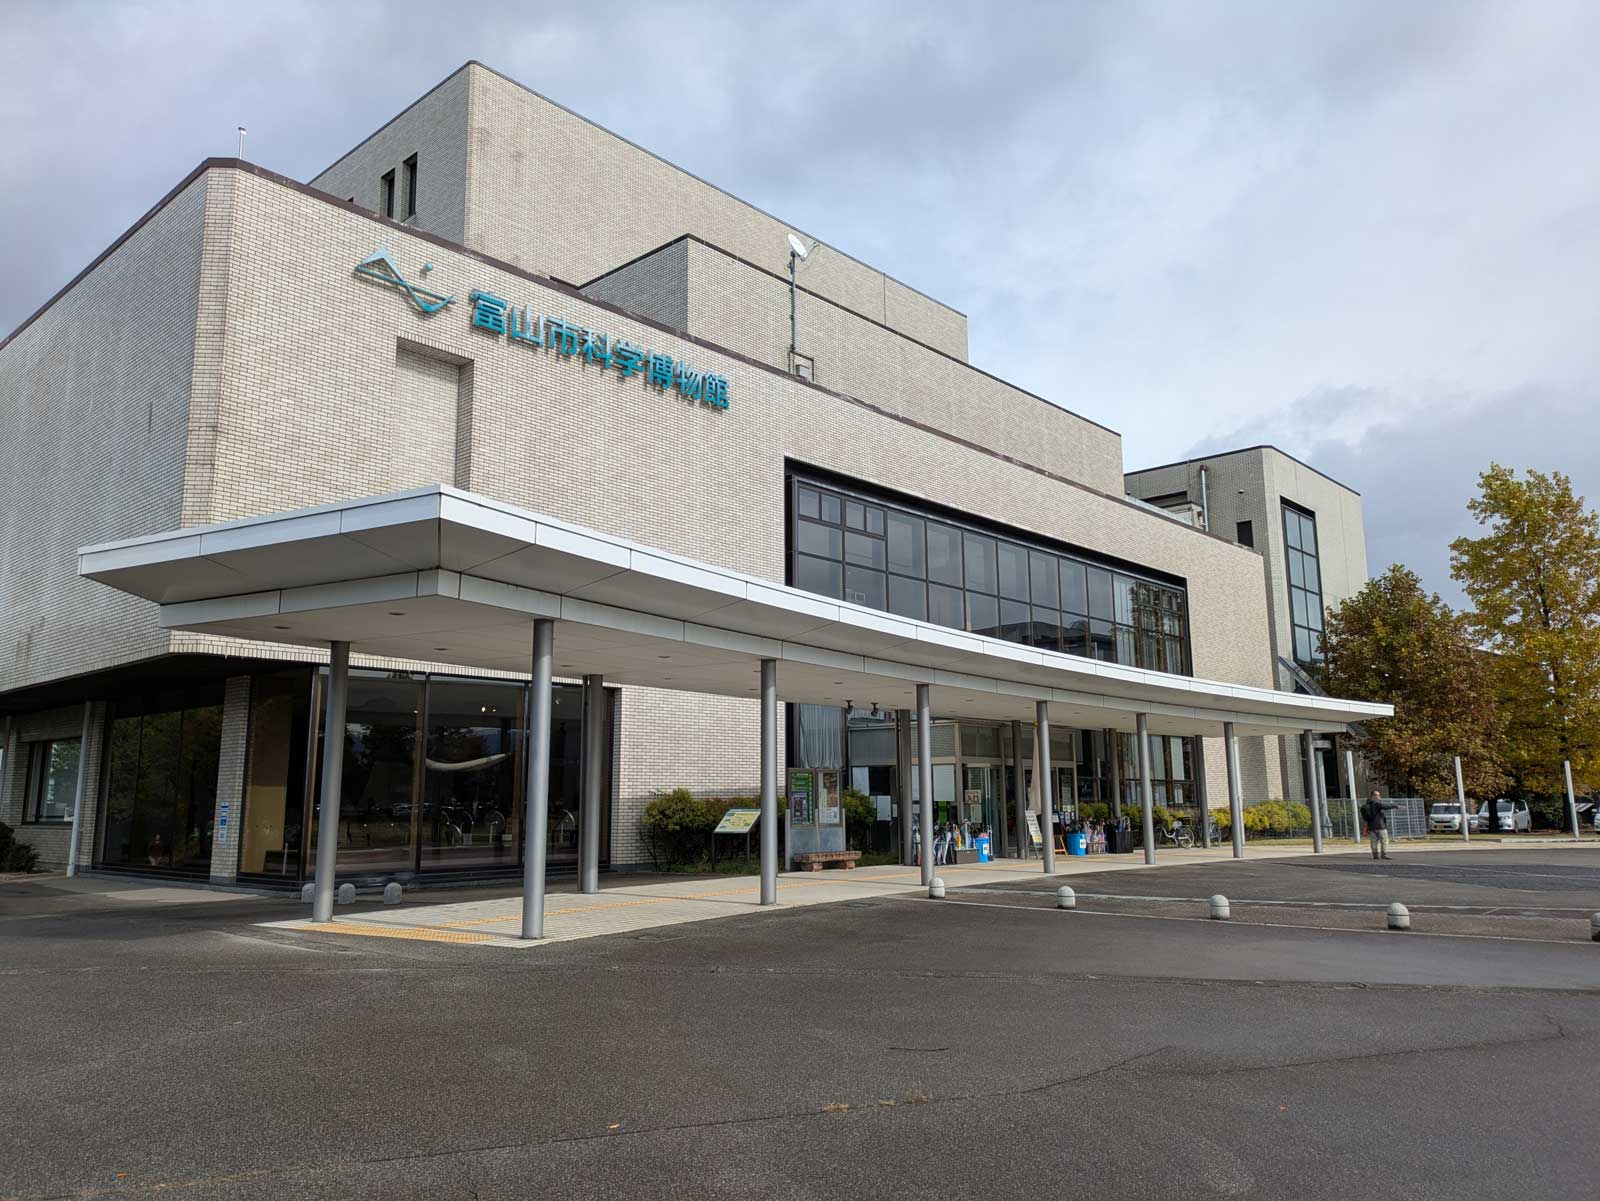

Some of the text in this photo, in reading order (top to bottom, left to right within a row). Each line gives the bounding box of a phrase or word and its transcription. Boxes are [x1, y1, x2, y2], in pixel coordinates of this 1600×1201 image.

[471, 288, 730, 410] 富山市科学博物館
